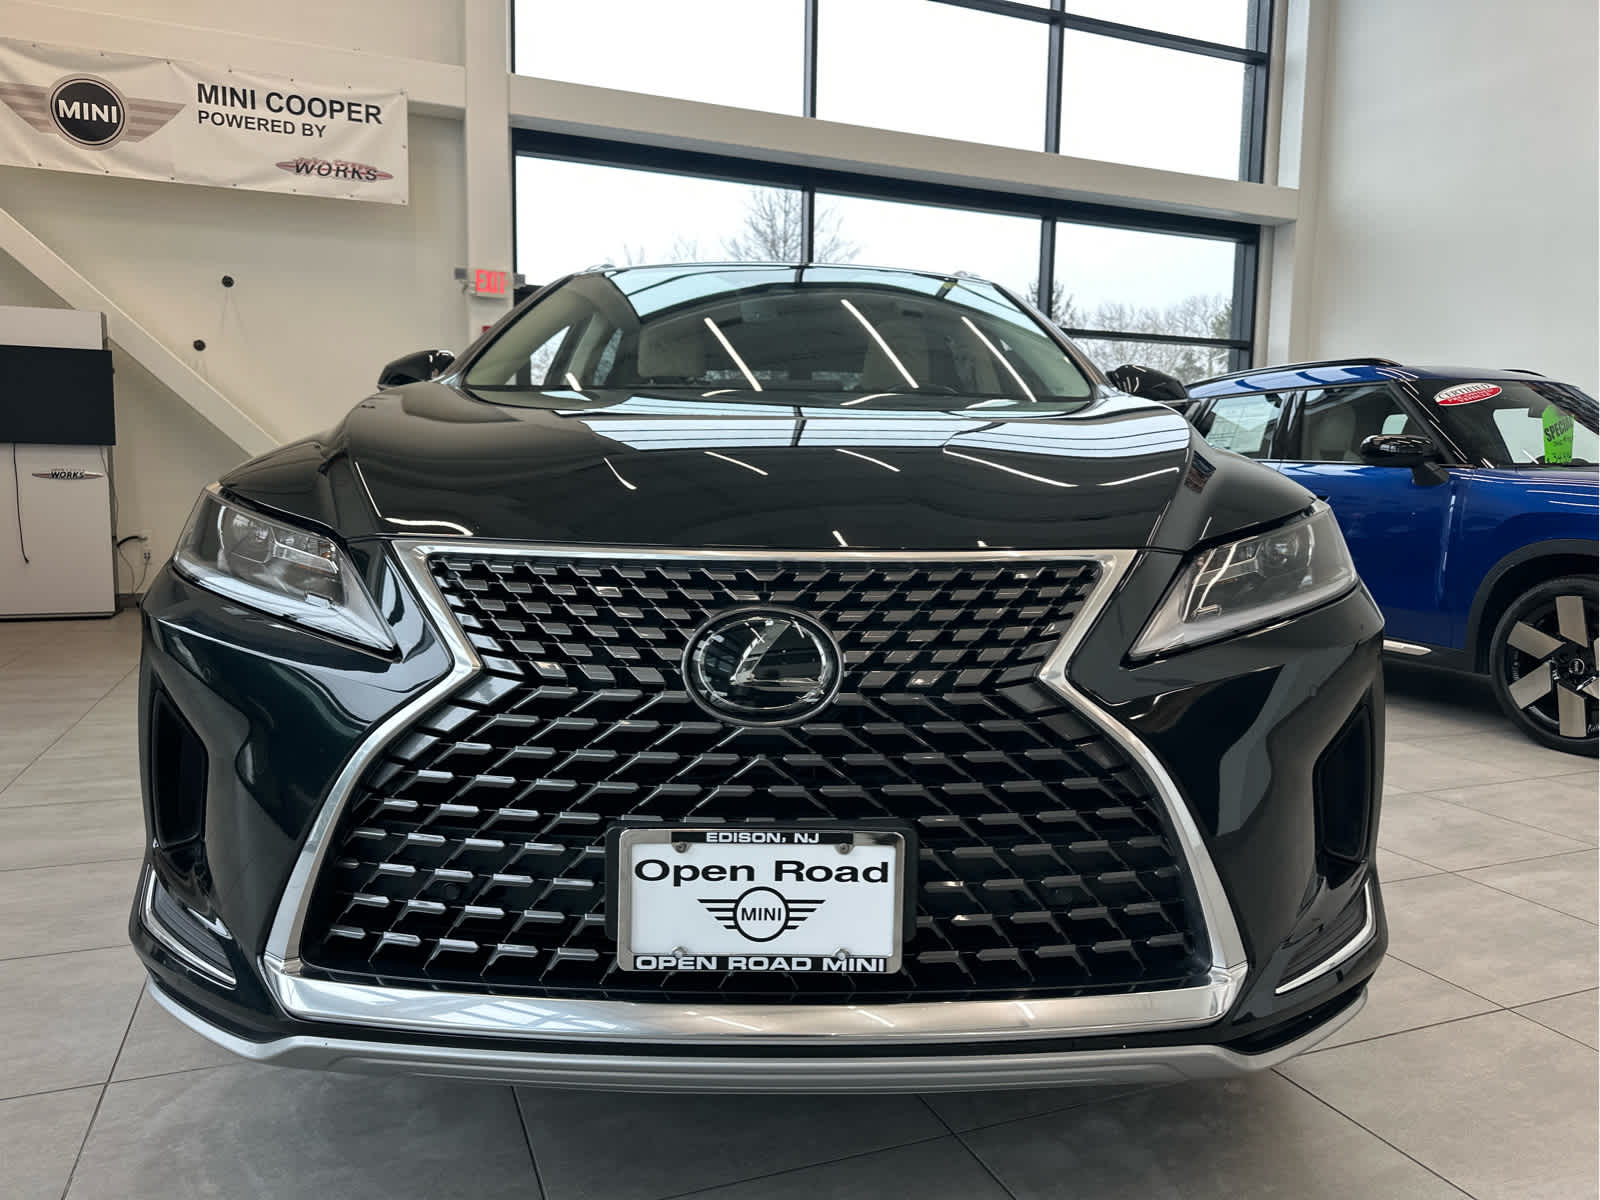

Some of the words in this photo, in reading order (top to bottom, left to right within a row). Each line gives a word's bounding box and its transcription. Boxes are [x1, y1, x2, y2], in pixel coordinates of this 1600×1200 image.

[58, 98, 119, 124] MINI
[197, 82, 256, 110] MINI
[265, 91, 383, 125] COOPER
[198, 110, 297, 136] POWERED
[301, 123, 326, 138] BY
[295, 162, 377, 181] WORKS
[475, 270, 505, 294] EXIT
[51, 471, 84, 480] WORKS
[706, 831, 786, 844] EDISON,
[794, 831, 820, 844] NJ
[634, 859, 755, 887] Open
[774, 860, 889, 883] Road
[741, 907, 783, 922] MINI
[635, 956, 717, 971] OPEN
[728, 957, 812, 971] ROAD
[823, 957, 885, 972] MINI
